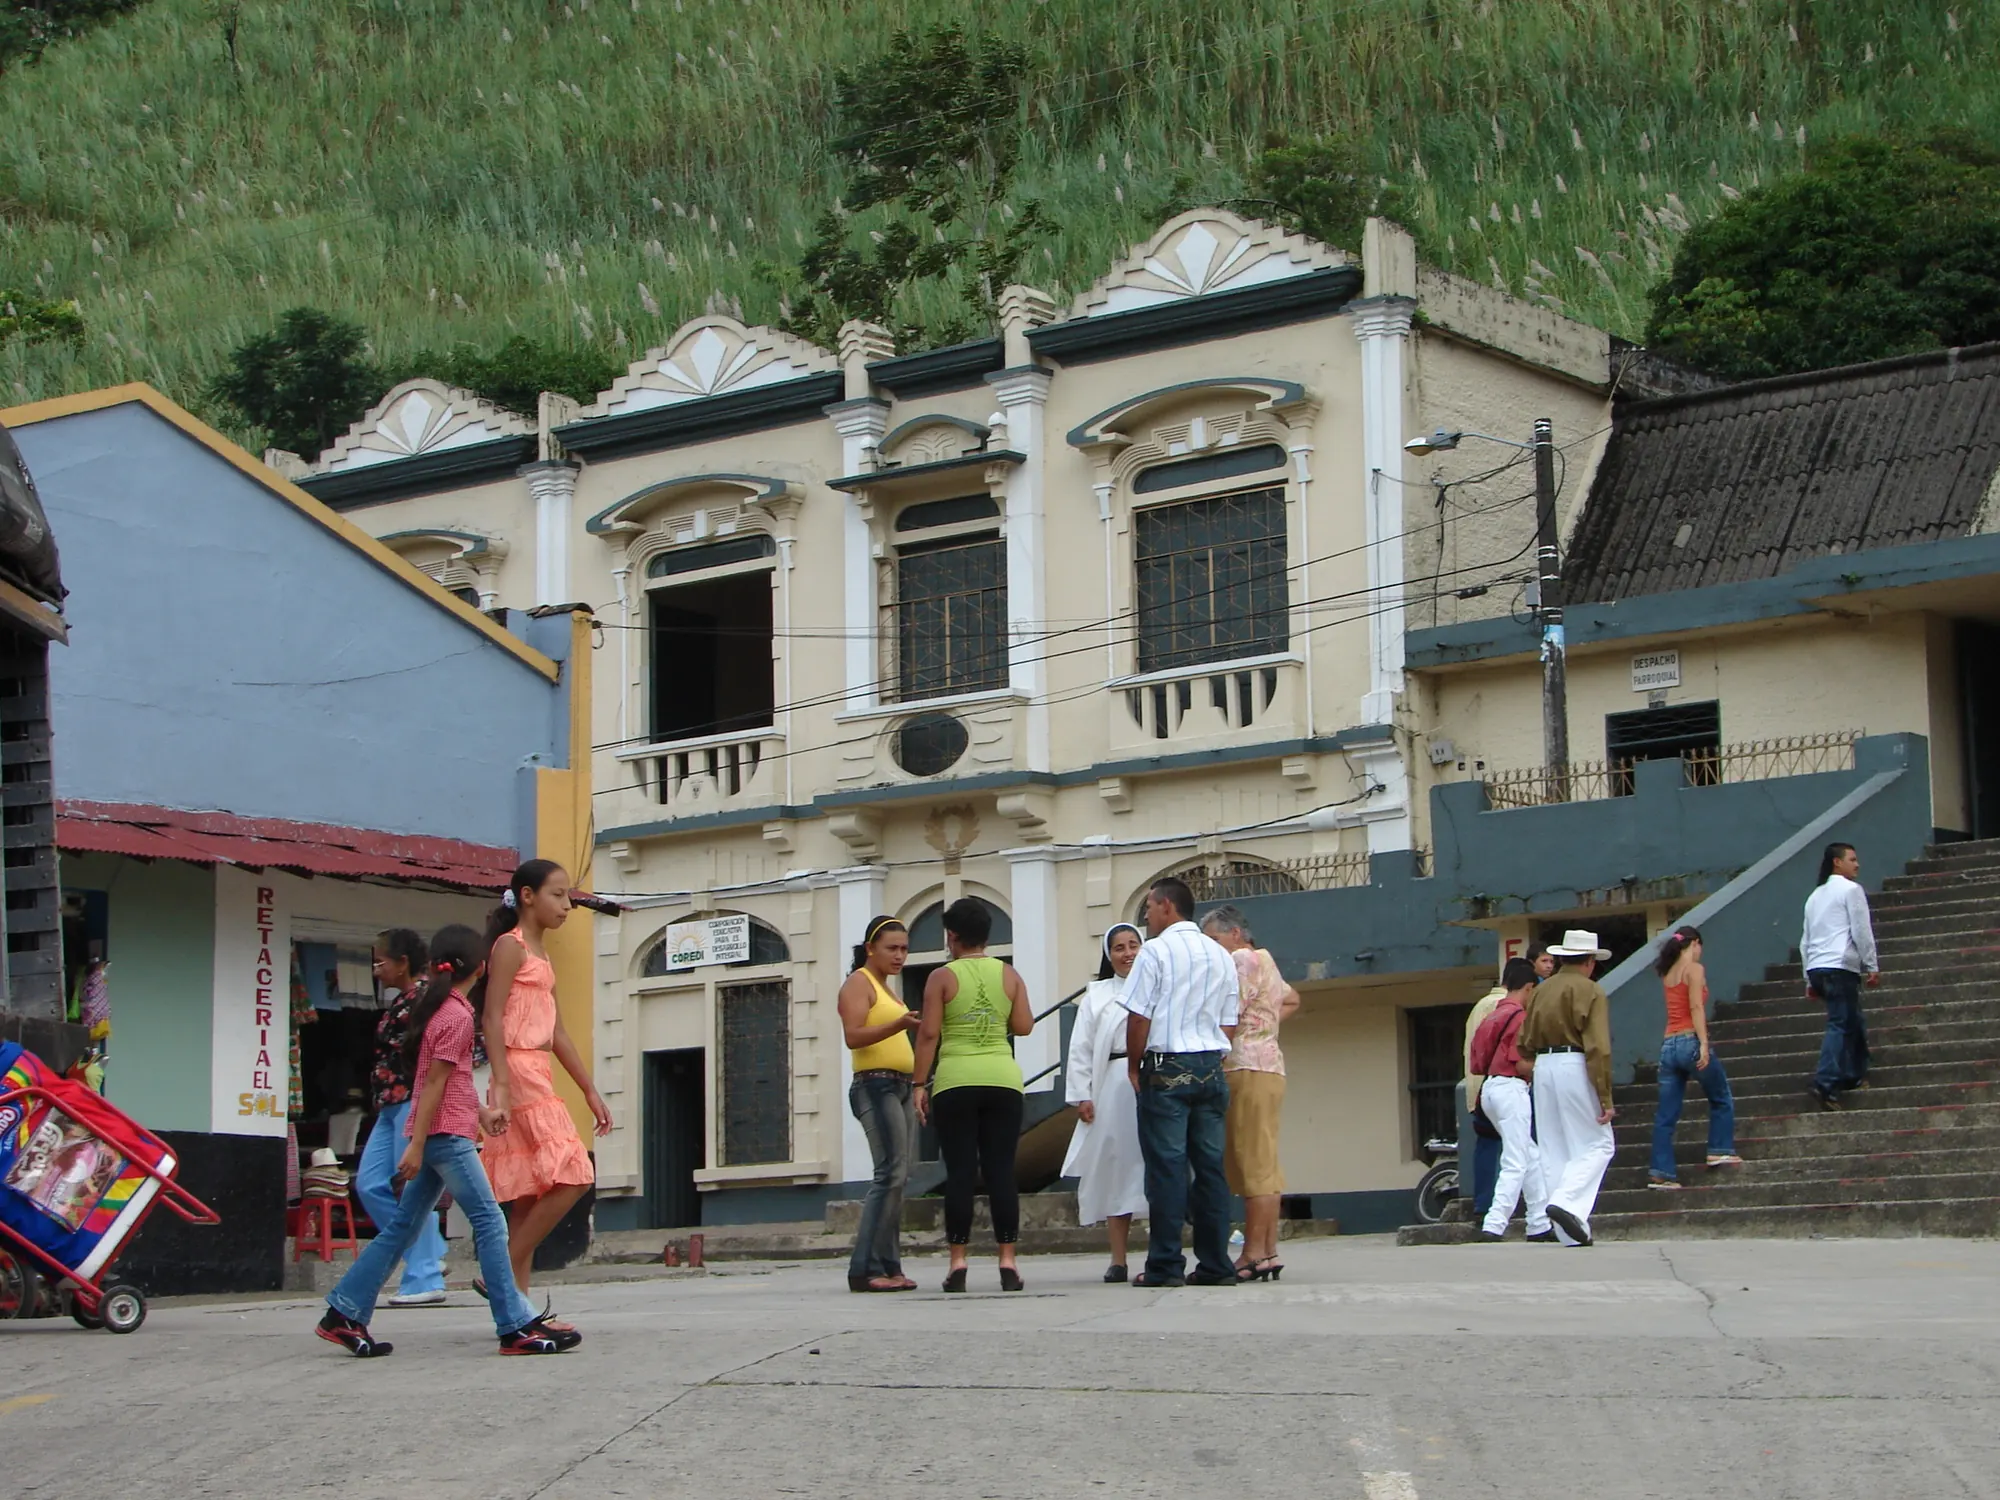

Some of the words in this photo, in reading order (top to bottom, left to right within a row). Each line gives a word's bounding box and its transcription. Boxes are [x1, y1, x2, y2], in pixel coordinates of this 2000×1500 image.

[1634, 654, 1676, 669] DESPACHO
[713, 926, 742, 936] EDUCATIVA
[712, 942, 747, 953] DESARROLLO
[672, 950, 704, 963] COREDI
[715, 951, 742, 961] INTEGRAL
[255, 886, 274, 1067] RETACERIA
[253, 1071, 273, 1090] EL
[238, 1092, 286, 1118] SOL
